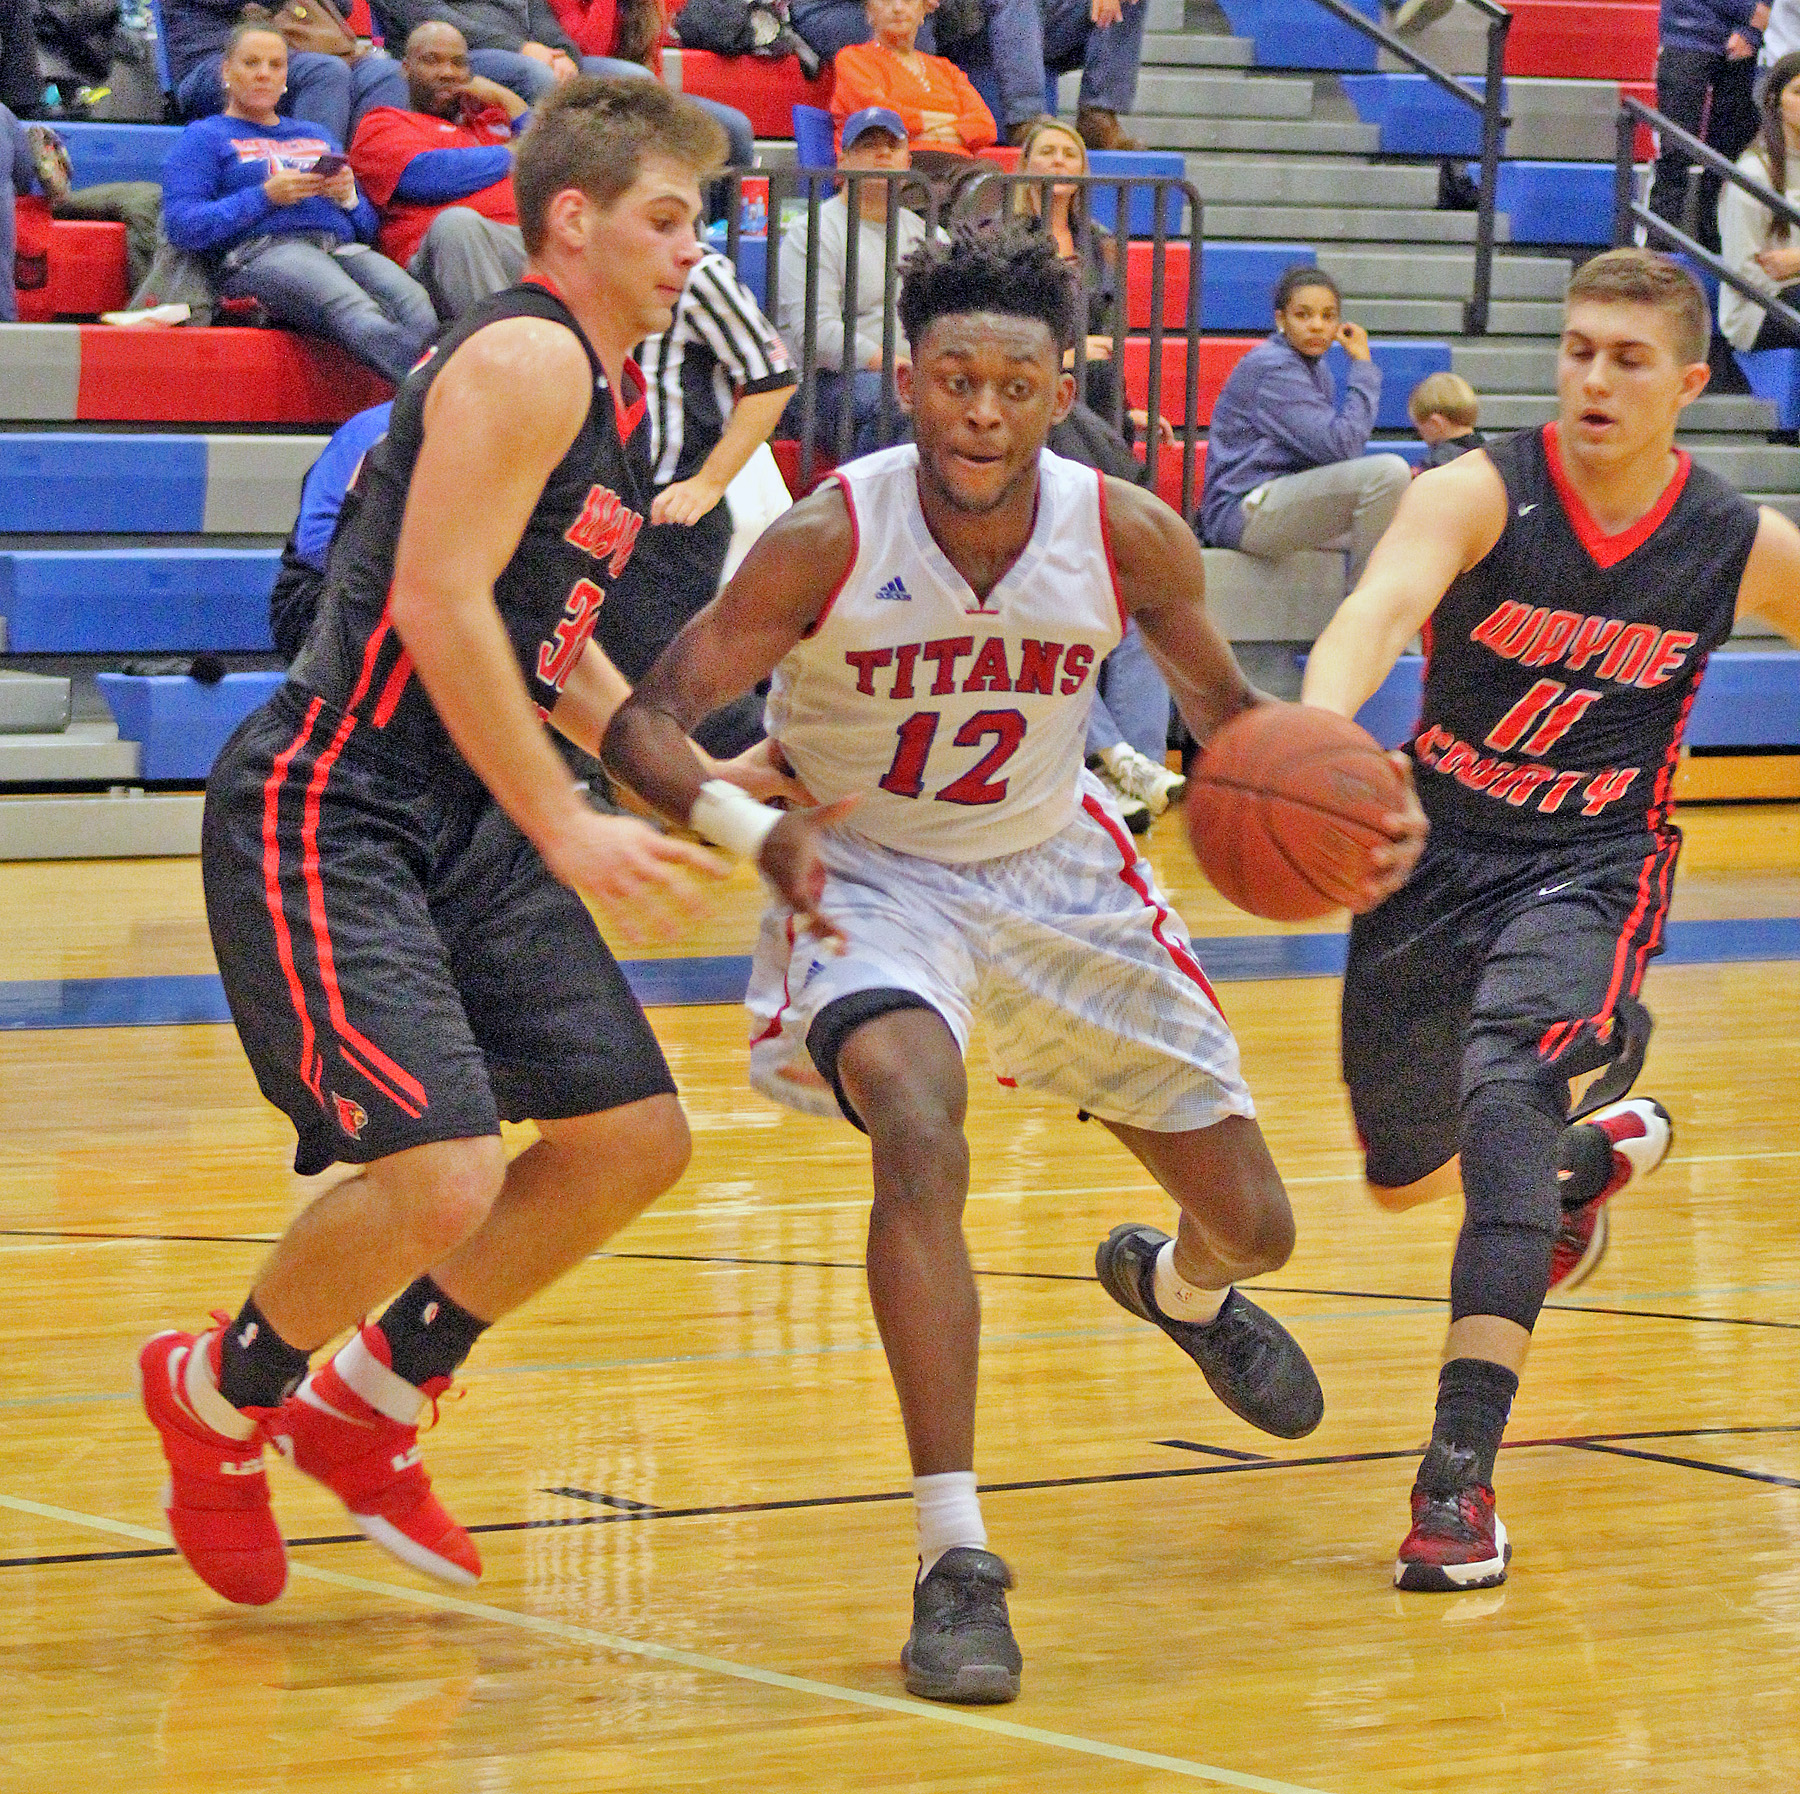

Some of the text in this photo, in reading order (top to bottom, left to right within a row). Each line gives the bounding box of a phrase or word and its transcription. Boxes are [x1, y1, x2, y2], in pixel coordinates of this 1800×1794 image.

[845, 635, 1095, 700] TITANS
[1470, 599, 1699, 689] WAYNE
[878, 708, 1028, 806] 12
[1483, 677, 1604, 757] 11
[1415, 724, 1641, 817] COUNTY
